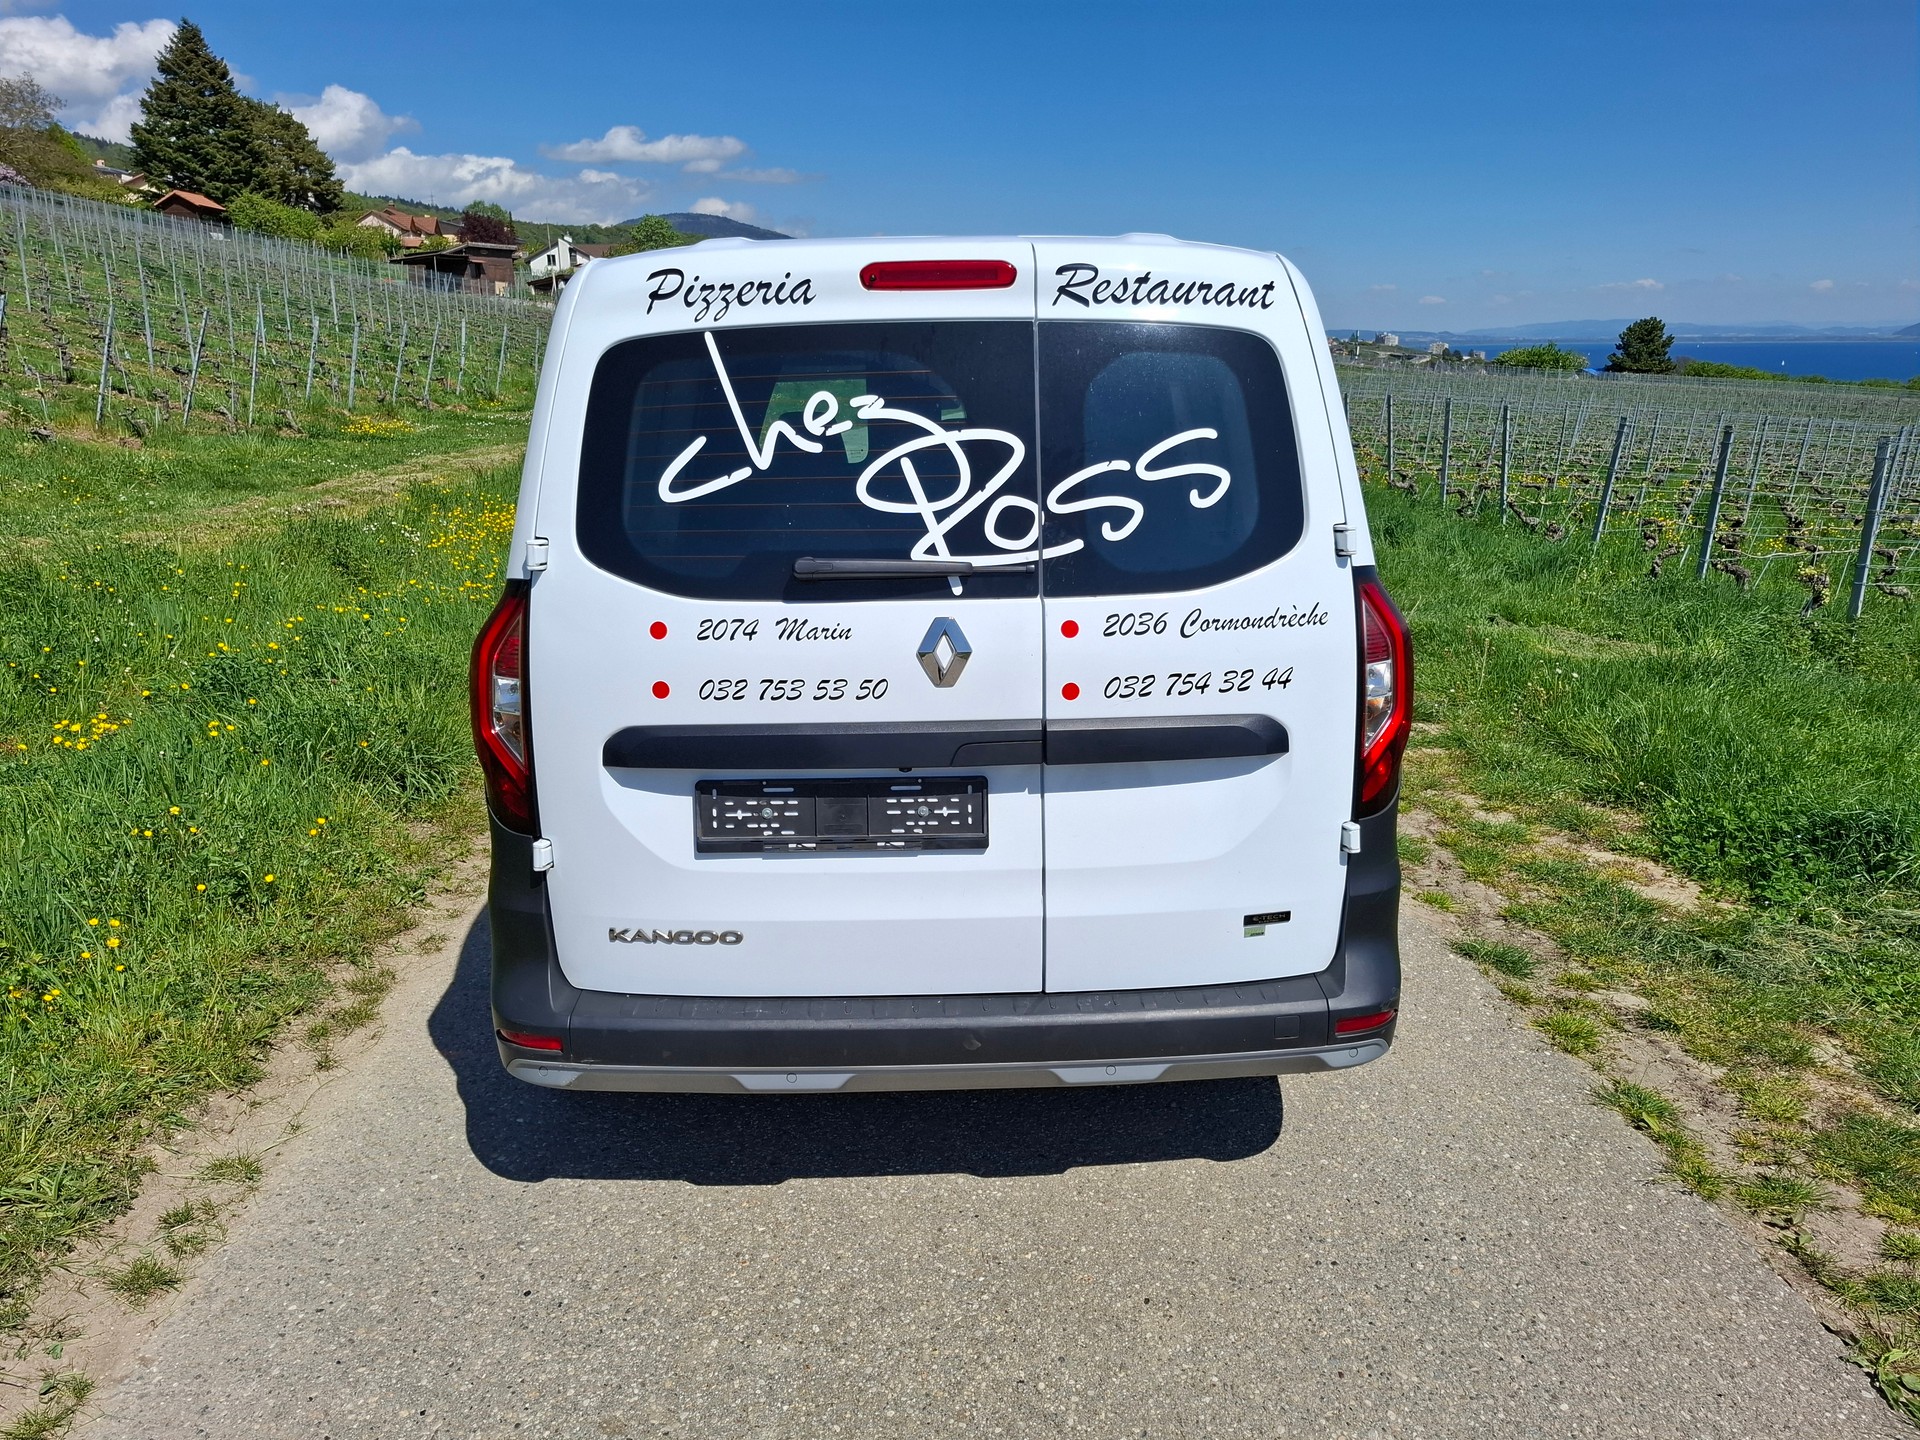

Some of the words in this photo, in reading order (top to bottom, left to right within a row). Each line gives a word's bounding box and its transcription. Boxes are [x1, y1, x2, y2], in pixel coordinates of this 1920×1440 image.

[646, 268, 817, 323] Pizzeria
[1052, 262, 1275, 309] Restaurant
[696, 618, 759, 642] 2074
[775, 617, 852, 642] Marin
[1102, 612, 1169, 637] 2036
[1179, 601, 1329, 638] Cormondrèche
[698, 678, 749, 701] 032
[759, 678, 806, 701] 753
[812, 678, 849, 701] 53
[855, 678, 889, 701] 50
[1103, 674, 1156, 698] 032
[1166, 671, 1212, 697] 754
[1218, 668, 1255, 693] 32
[1261, 666, 1294, 691] 44
[608, 927, 744, 946] KANGOO
